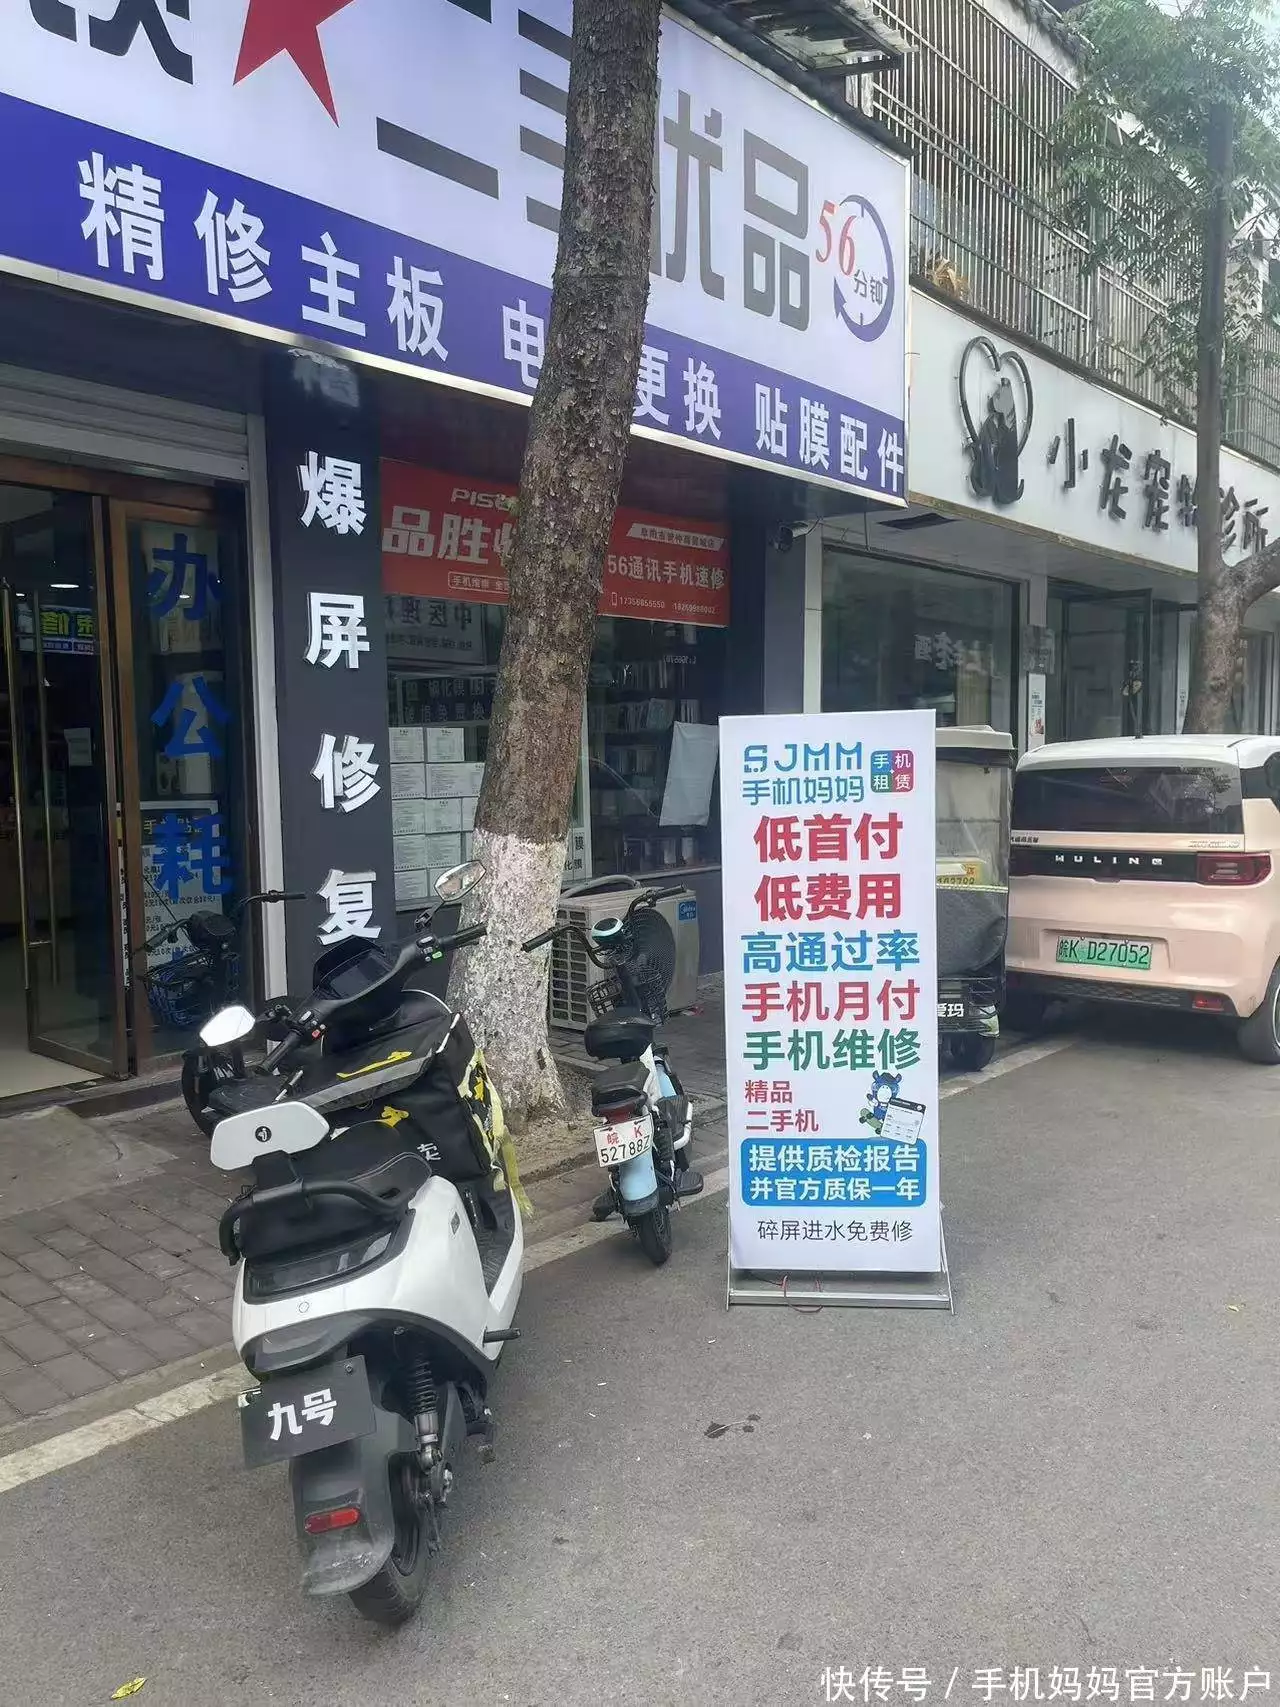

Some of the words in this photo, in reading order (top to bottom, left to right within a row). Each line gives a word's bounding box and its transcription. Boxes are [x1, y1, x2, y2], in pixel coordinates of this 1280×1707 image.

[815, 200, 857, 276] 56
[79, 151, 448, 361] 精修主板
[503, 301, 722, 441] 电更换
[753, 382, 905, 494] 贴膜配件
[607, 554, 725, 589] 56通讯手机速修
[297, 450, 382, 945] 爆屏修复
[743, 742, 862, 773] SJMM
[874, 752, 911, 769] 手机
[742, 775, 865, 805] 手机妈妈
[873, 775, 911, 790] 租赁
[753, 812, 903, 863] 低首付
[1055, 855, 1163, 865] WULING
[754, 872, 903, 921] 低费用
[740, 929, 920, 973] 高通过率
[742, 979, 920, 1022] 手机月付
[743, 1028, 921, 1071] 手机维修
[745, 1080, 793, 1103] 精品
[745, 1108, 819, 1133] 二手机
[749, 1144, 920, 1173] 提供质检报告
[751, 1177, 920, 1201] 并官方质保一年
[757, 1220, 913, 1242] 碎屏进水免费修
[267, 1389, 337, 1441] 九号
